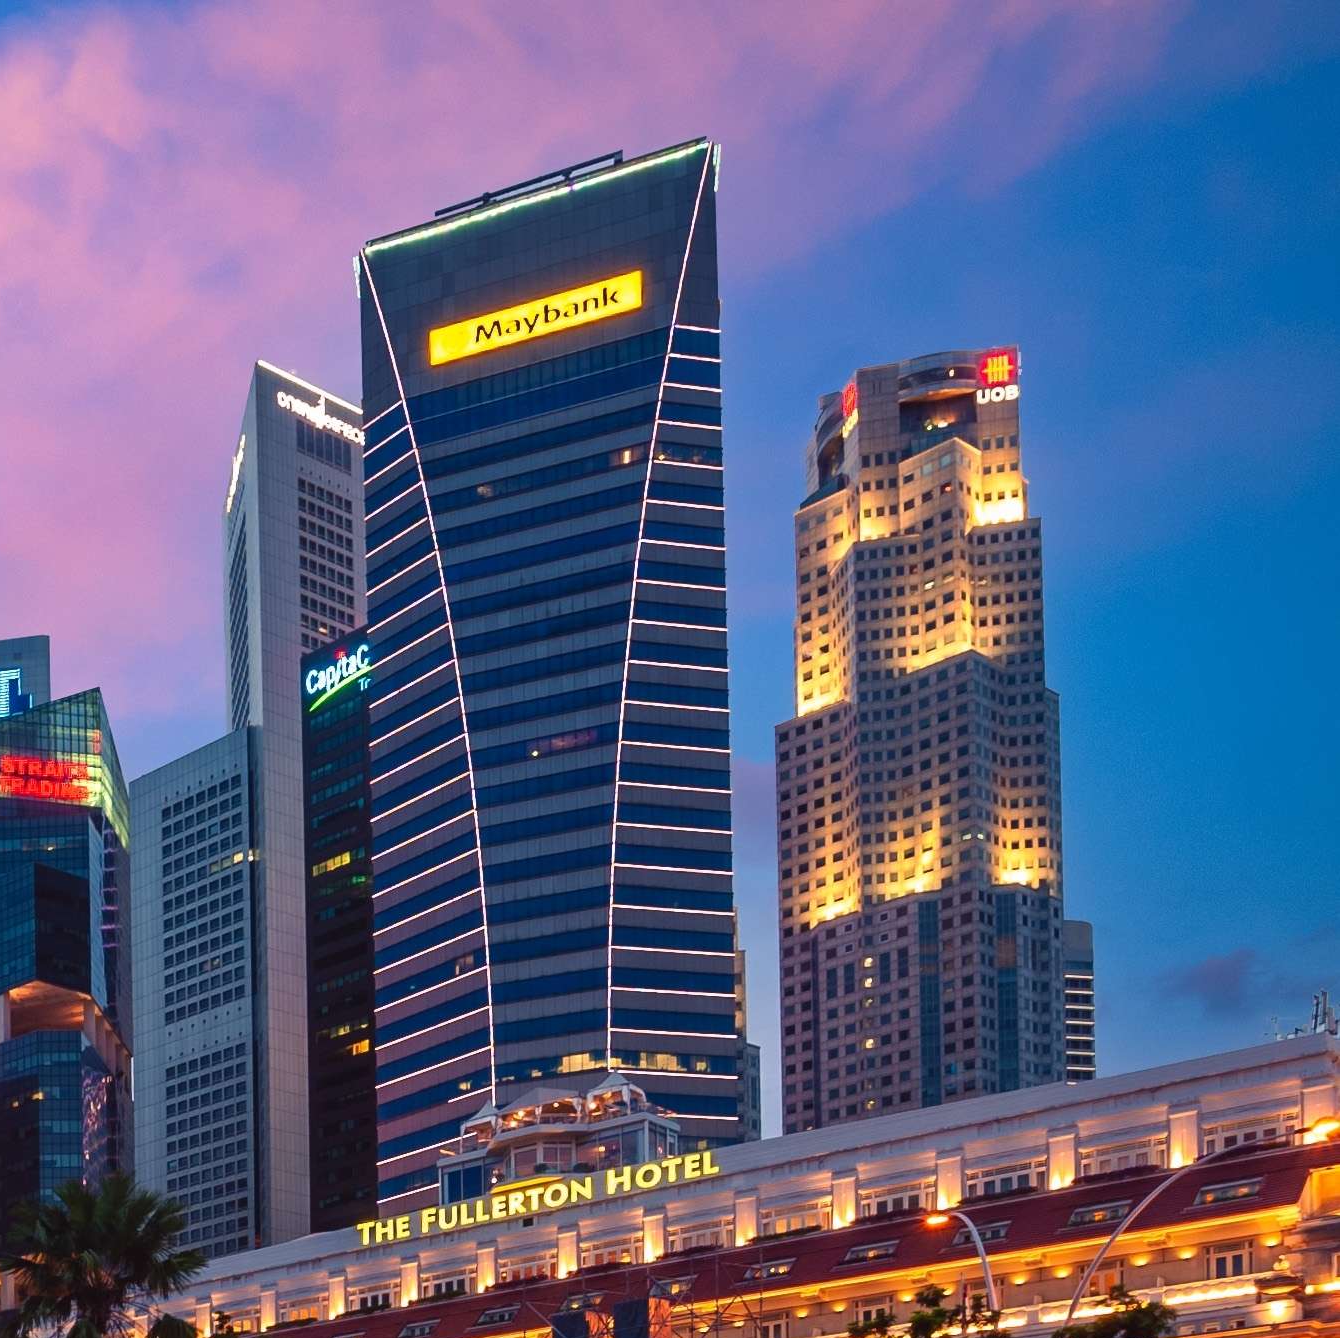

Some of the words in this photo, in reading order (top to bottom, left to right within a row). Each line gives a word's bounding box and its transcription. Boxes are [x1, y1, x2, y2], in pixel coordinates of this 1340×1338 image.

[475, 287, 618, 343] Maybank
[976, 384, 1020, 405] UOB
[356, 1215, 411, 1246] THE
[421, 1177, 592, 1234] FULLERTON
[606, 1151, 720, 1195] HOTEL
